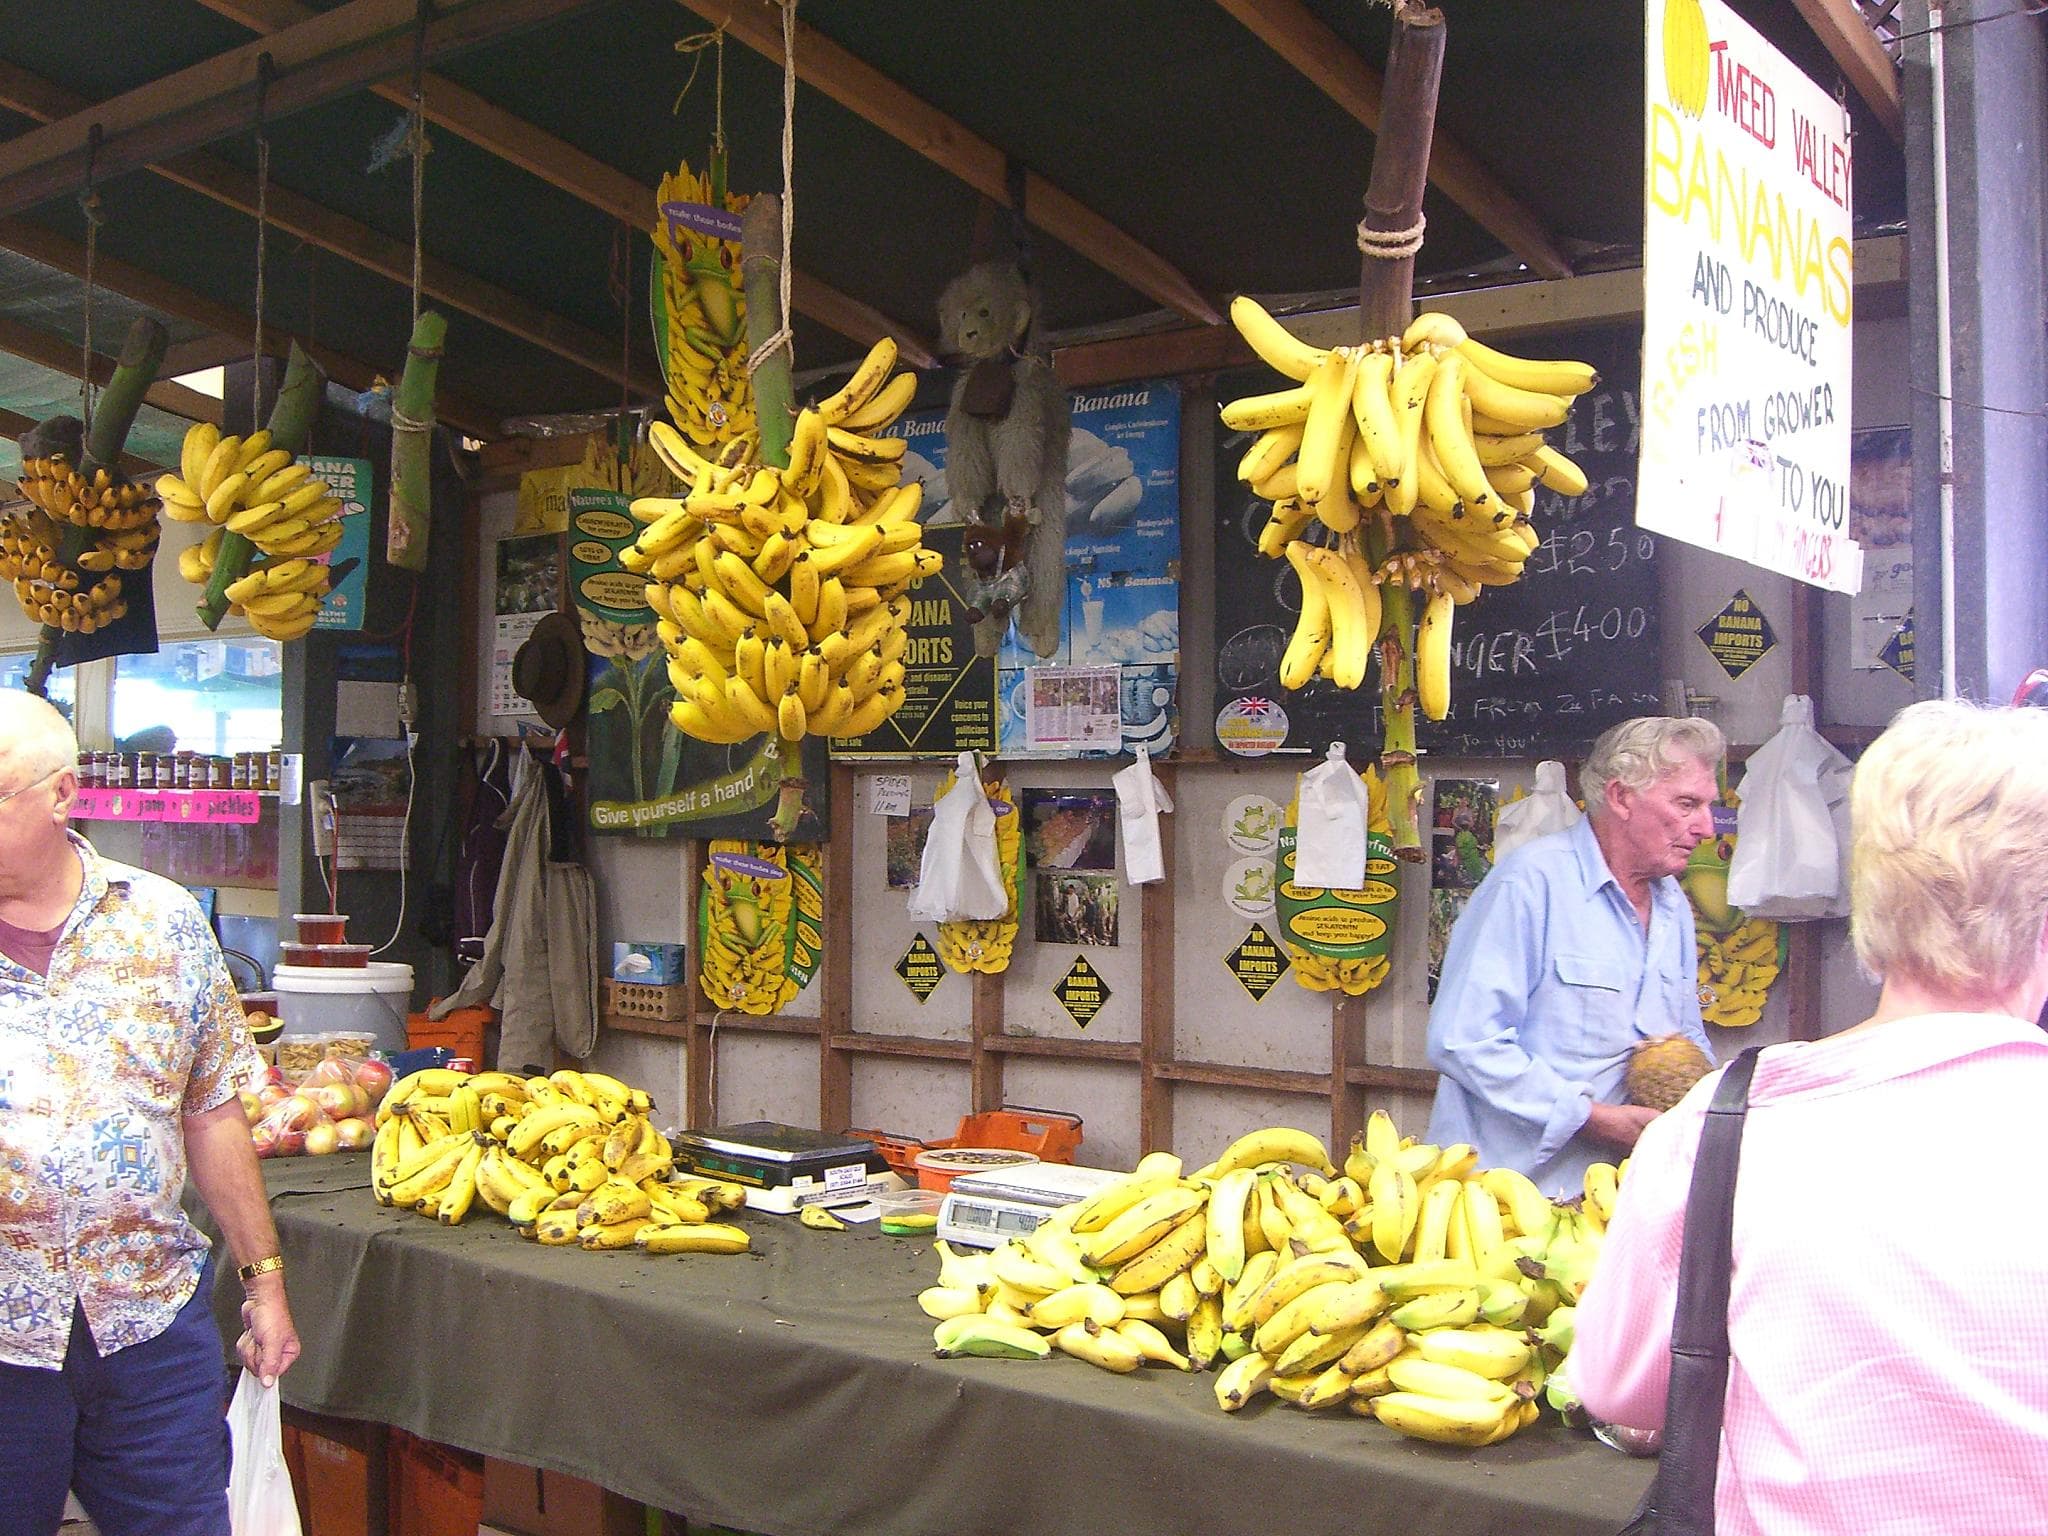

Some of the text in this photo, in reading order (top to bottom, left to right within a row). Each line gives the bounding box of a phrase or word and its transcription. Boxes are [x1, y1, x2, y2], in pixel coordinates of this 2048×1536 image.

[1710, 40, 1852, 212] TWEED VALLEY
[1651, 103, 1852, 328] BANANAS
[1692, 250, 1818, 367] AND PRODUCE
[1072, 390, 1150, 414] Banana
[1698, 382, 1834, 455] FROM GROWER
[1776, 455, 1803, 513] TO
[1812, 471, 1844, 530] YOU
[1124, 577, 1175, 587] Bananas
[1734, 599, 1749, 612] NO
[1719, 615, 1761, 630] BANANA
[1714, 632, 1763, 648] IMPORTS
[951, 713, 981, 722] concerns
[955, 725, 989, 735] politicians
[955, 738, 989, 747] and media
[595, 767, 755, 827] Give yourself a hand
[138, 794, 166, 817] jam
[208, 796, 254, 817] pickles
[1252, 931, 1265, 941] NO
[916, 940, 926, 950] NO
[908, 953, 936, 963] BANANA
[1241, 946, 1276, 958] BANANA
[907, 966, 938, 977] IMPORTS
[1076, 962, 1088, 973] NO
[1239, 960, 1278, 973] IMPORTS
[1067, 976, 1098, 987] BANANA
[1065, 990, 1101, 1001] IMPORTS
